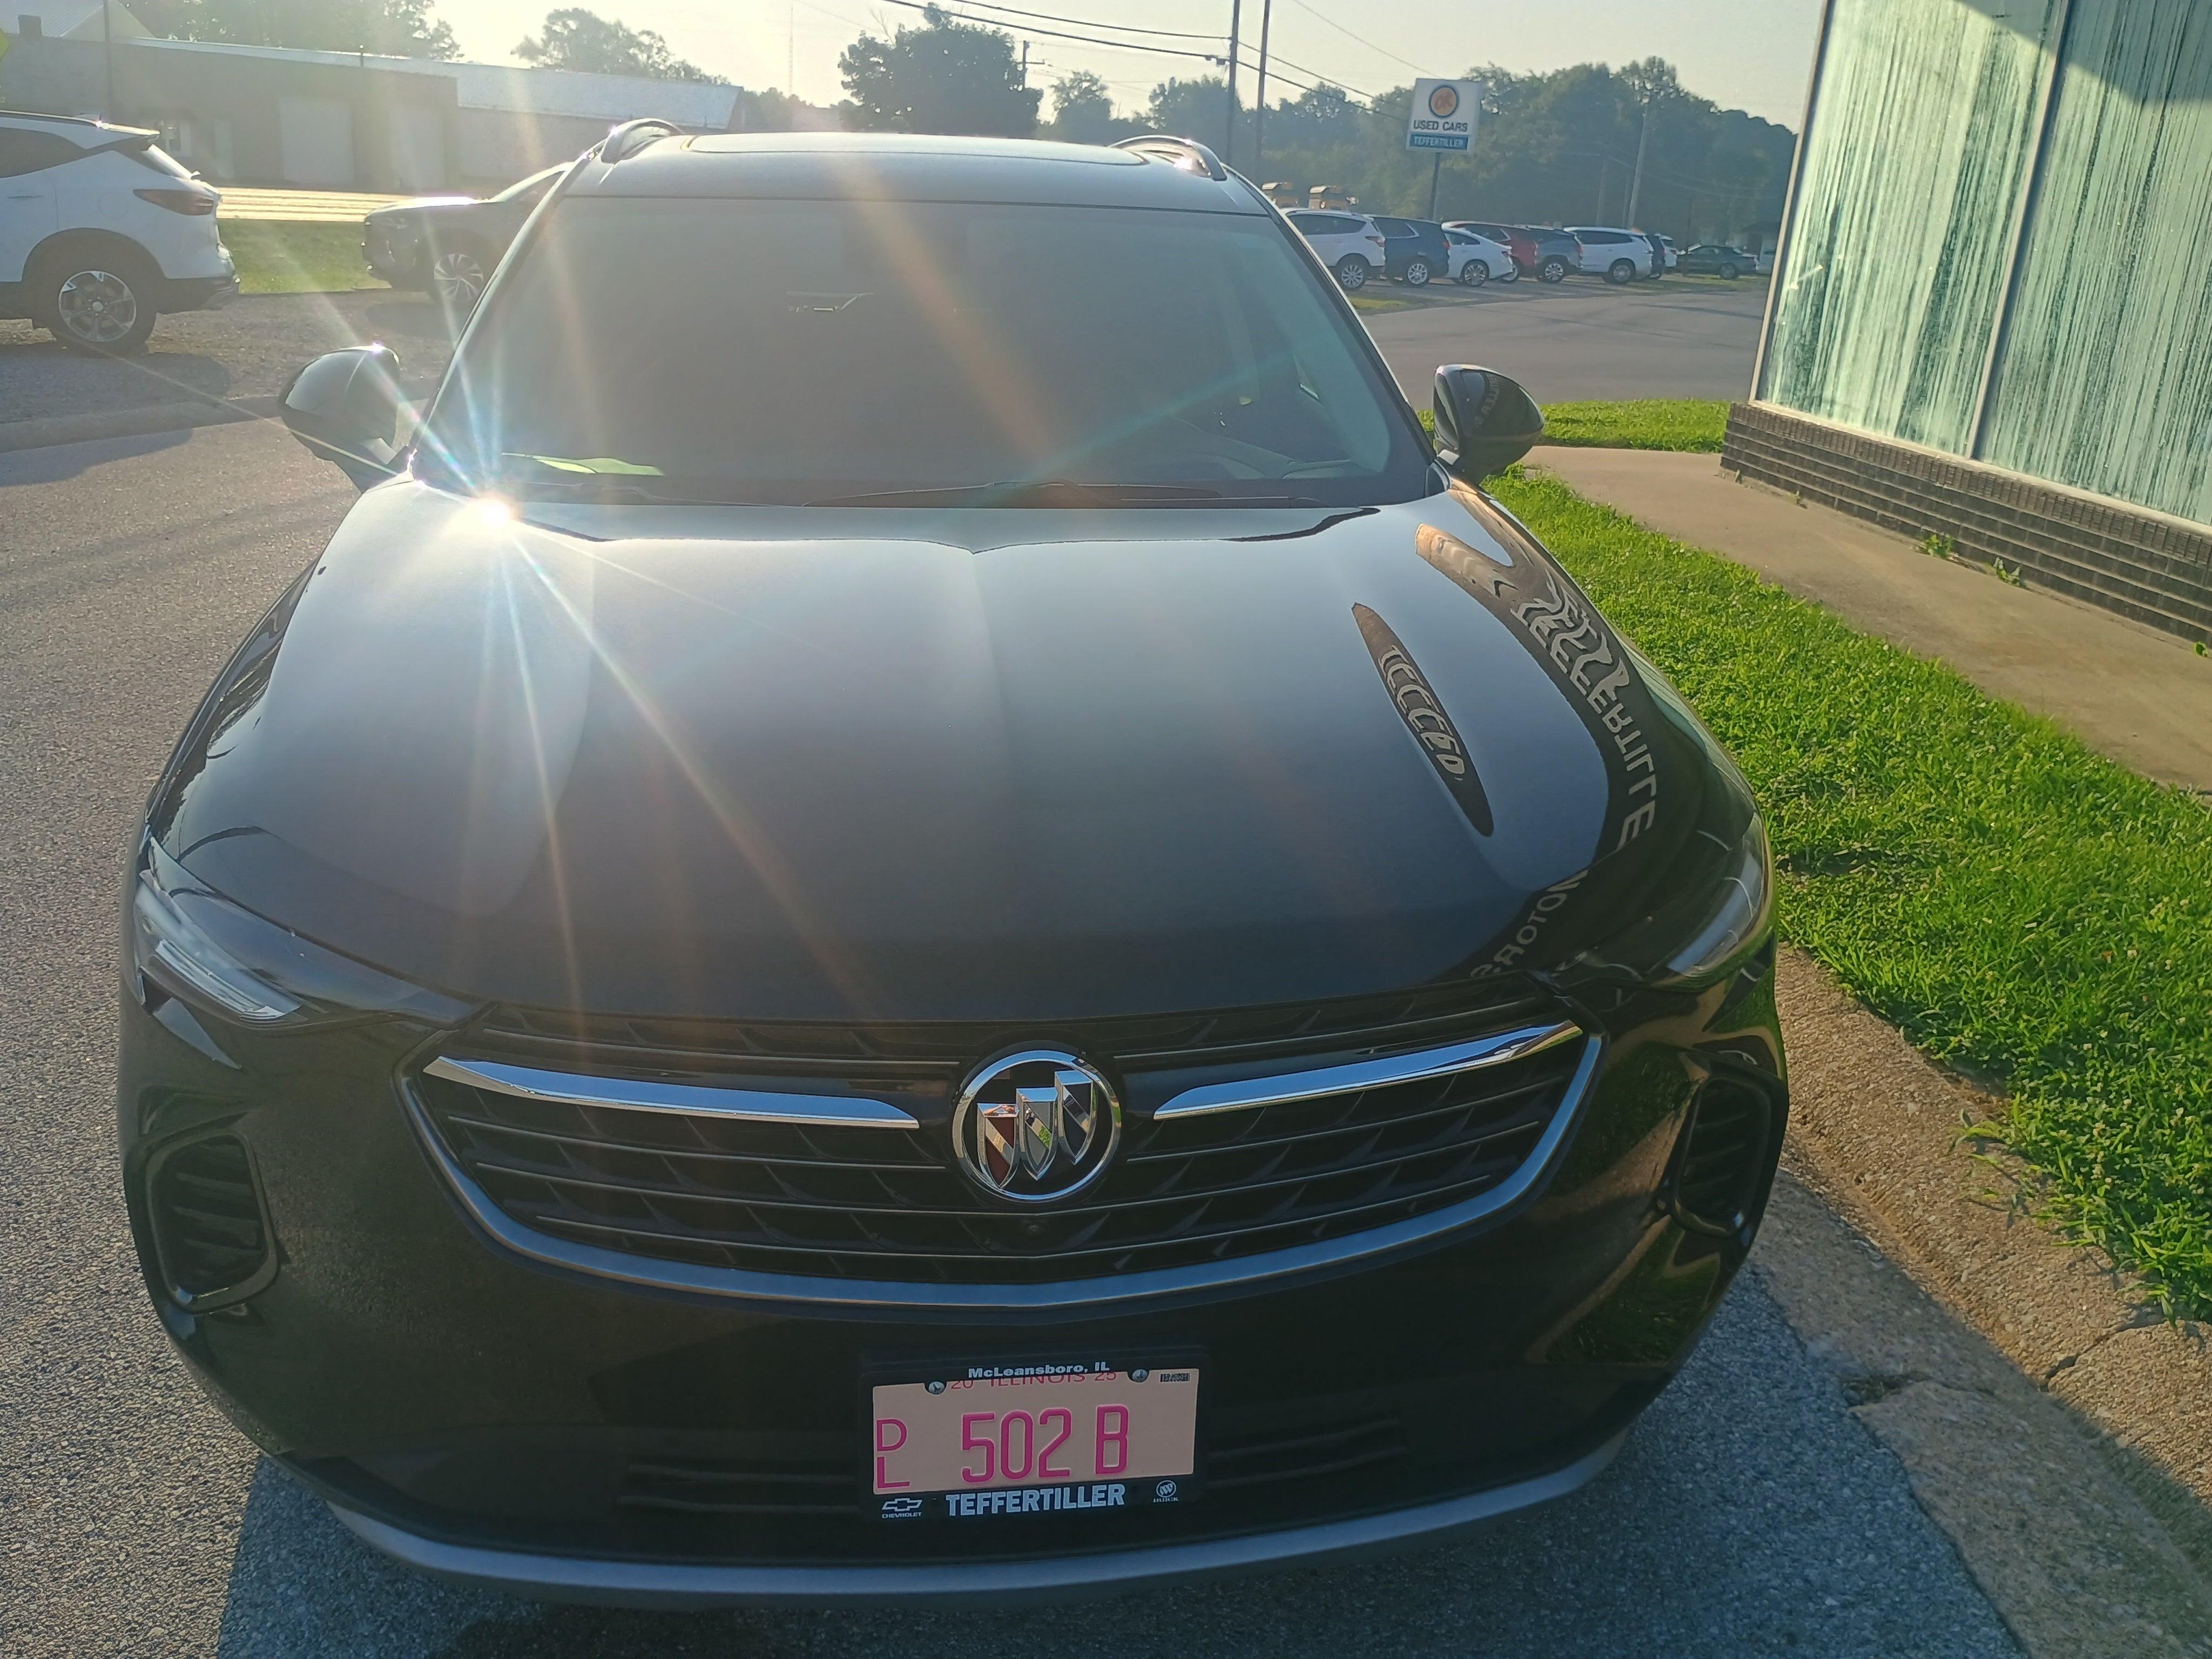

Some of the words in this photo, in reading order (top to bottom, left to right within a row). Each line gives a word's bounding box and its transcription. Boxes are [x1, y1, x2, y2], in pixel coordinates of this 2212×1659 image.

[1413, 120, 1439, 130] USED
[1442, 121, 1468, 132] CARS
[1414, 136, 1463, 148] TEFFERTILLER
[968, 1364, 1088, 1378] McLeansboro,
[1095, 1361, 1110, 1371] IL
[961, 1407, 1072, 1483] 502
[1095, 1404, 1129, 1475] B
[946, 1483, 1125, 1516] TEFFERTILLER
